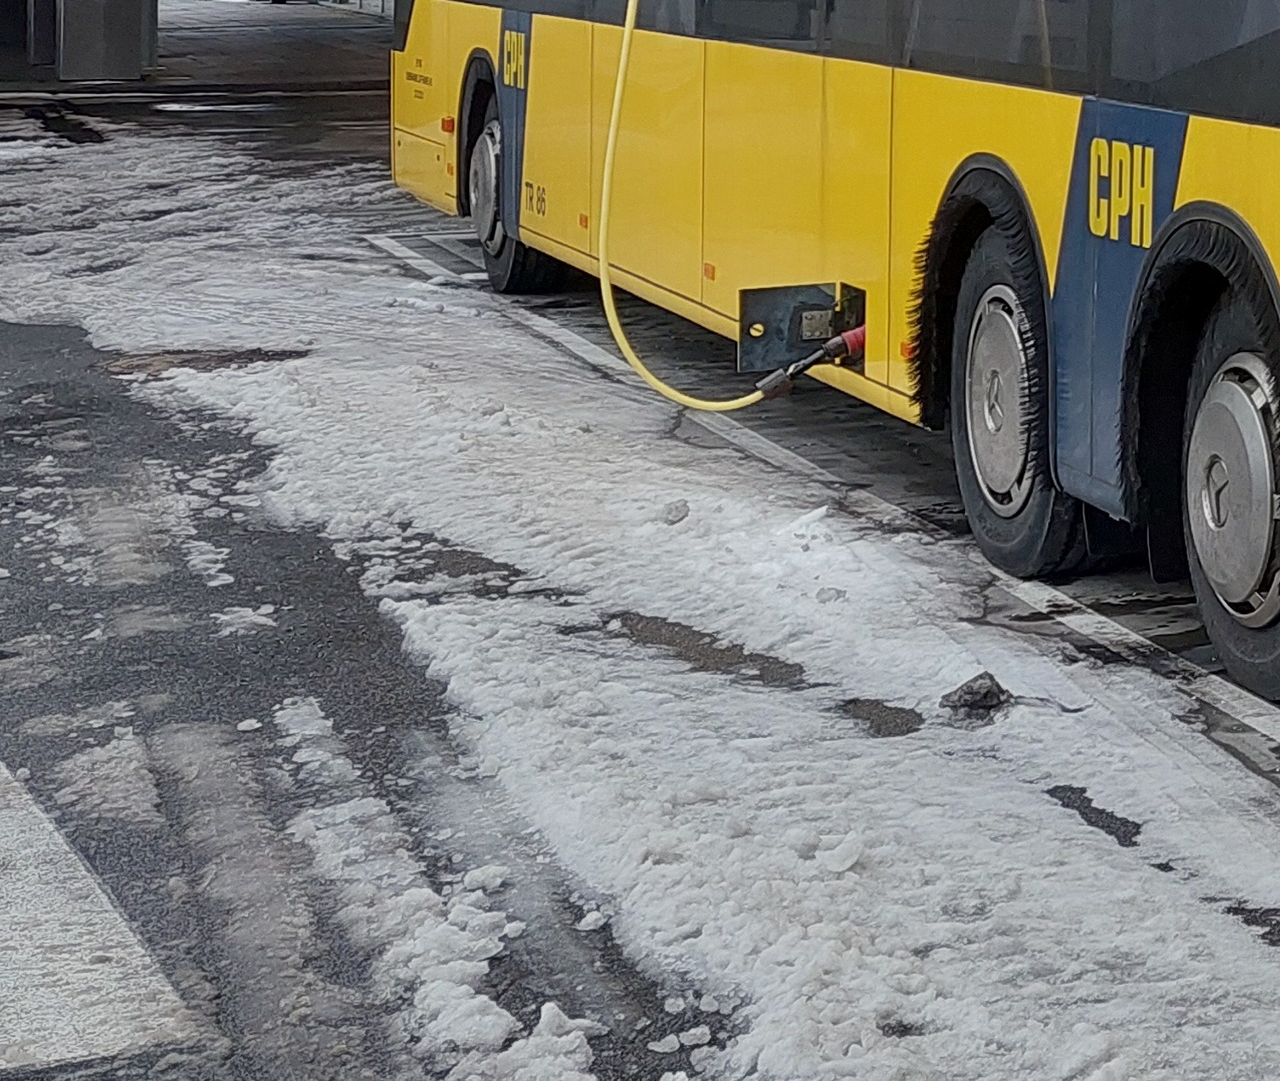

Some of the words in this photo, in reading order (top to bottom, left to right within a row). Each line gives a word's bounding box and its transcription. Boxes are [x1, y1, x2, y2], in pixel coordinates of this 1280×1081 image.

[503, 30, 526, 90] CPH
[525, 182, 534, 213] TR
[536, 186, 547, 217] 86
[1089, 137, 1154, 248] CPH
